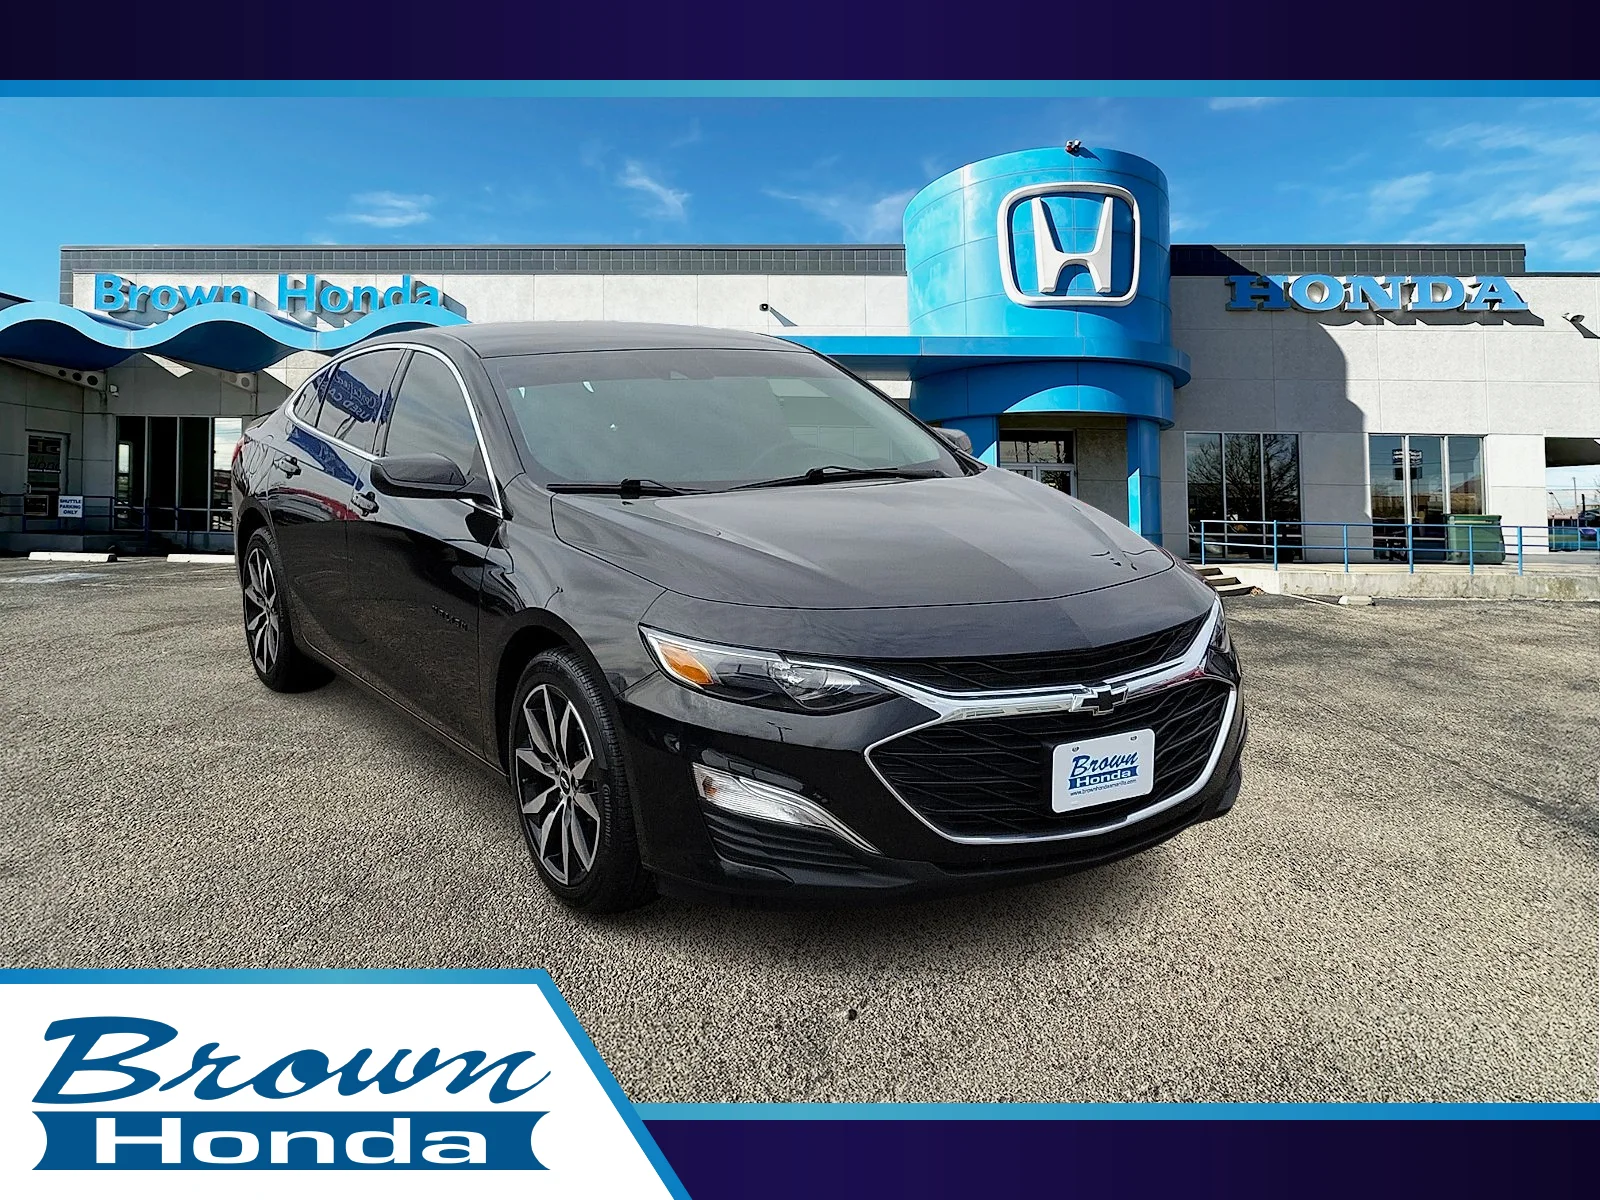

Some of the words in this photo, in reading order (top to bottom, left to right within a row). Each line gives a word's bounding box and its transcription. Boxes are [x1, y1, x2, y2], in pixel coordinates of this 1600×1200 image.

[94, 273, 249, 312] Brown
[277, 273, 439, 312] Honda
[1226, 274, 1529, 312] HONDA
[1069, 751, 1139, 778] Brown
[1076, 769, 1132, 788] Honda
